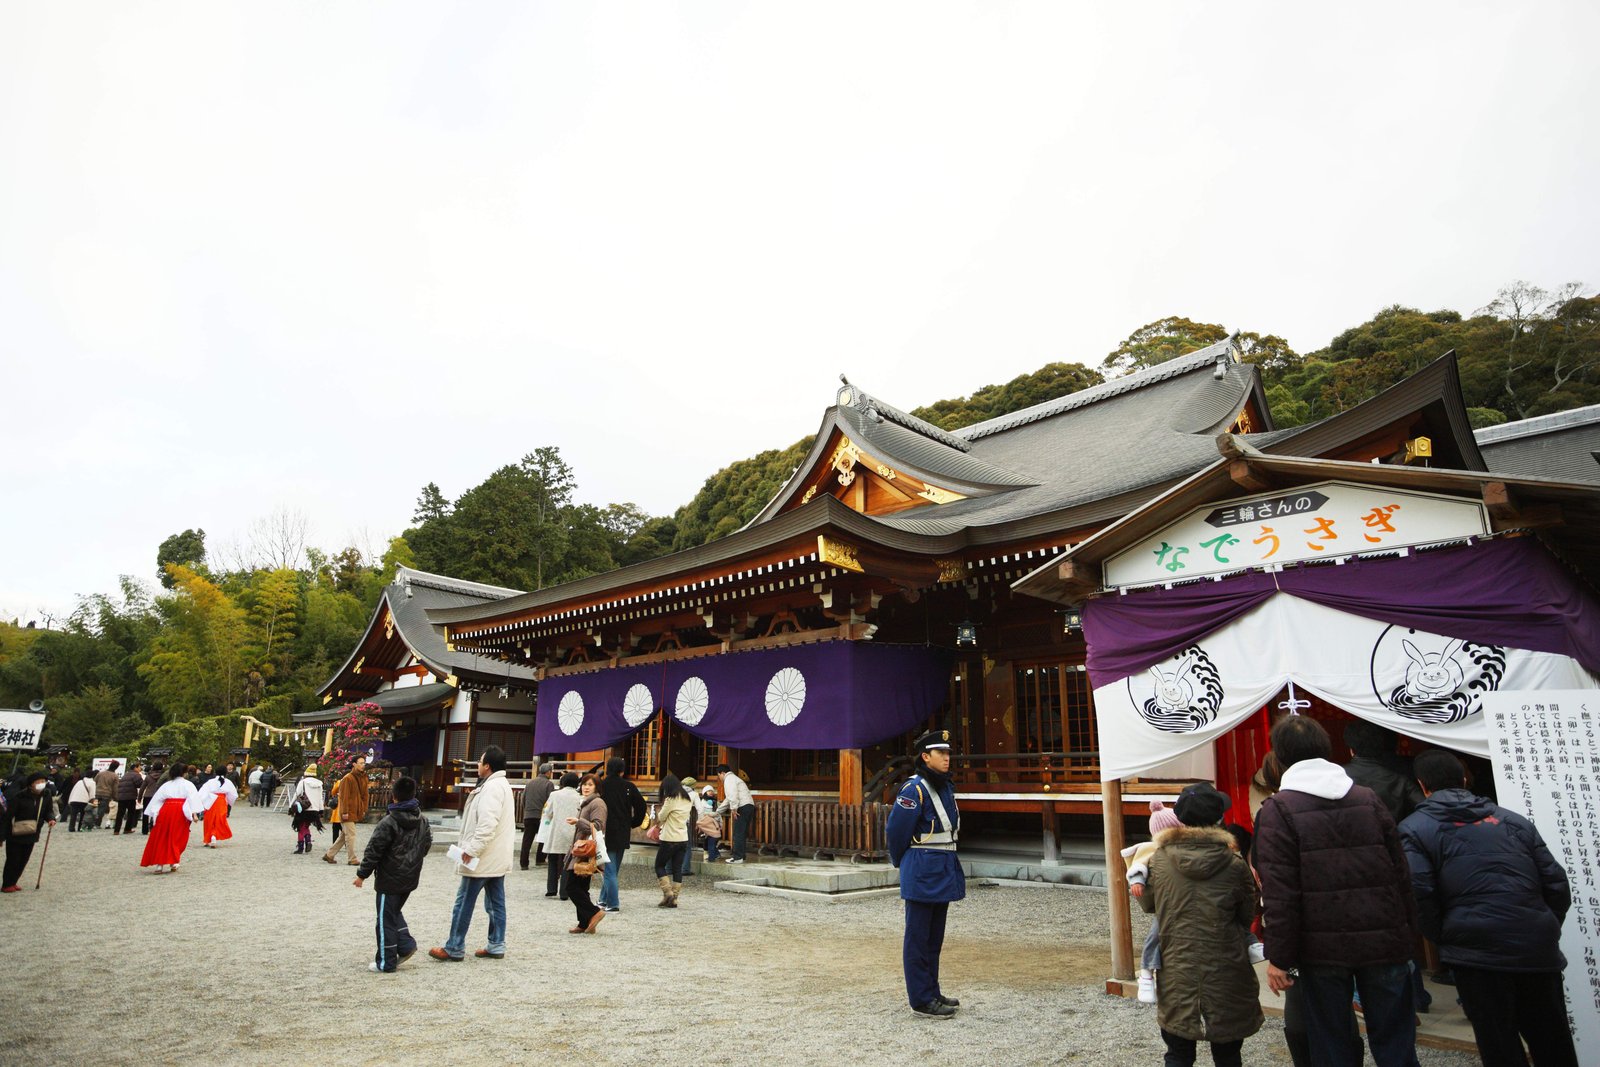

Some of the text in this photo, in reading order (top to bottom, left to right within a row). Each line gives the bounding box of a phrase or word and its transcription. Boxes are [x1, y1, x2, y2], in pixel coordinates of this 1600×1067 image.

[1221, 497, 1312, 524] 三輪さんの
[1153, 503, 1401, 572] なでうさぎ
